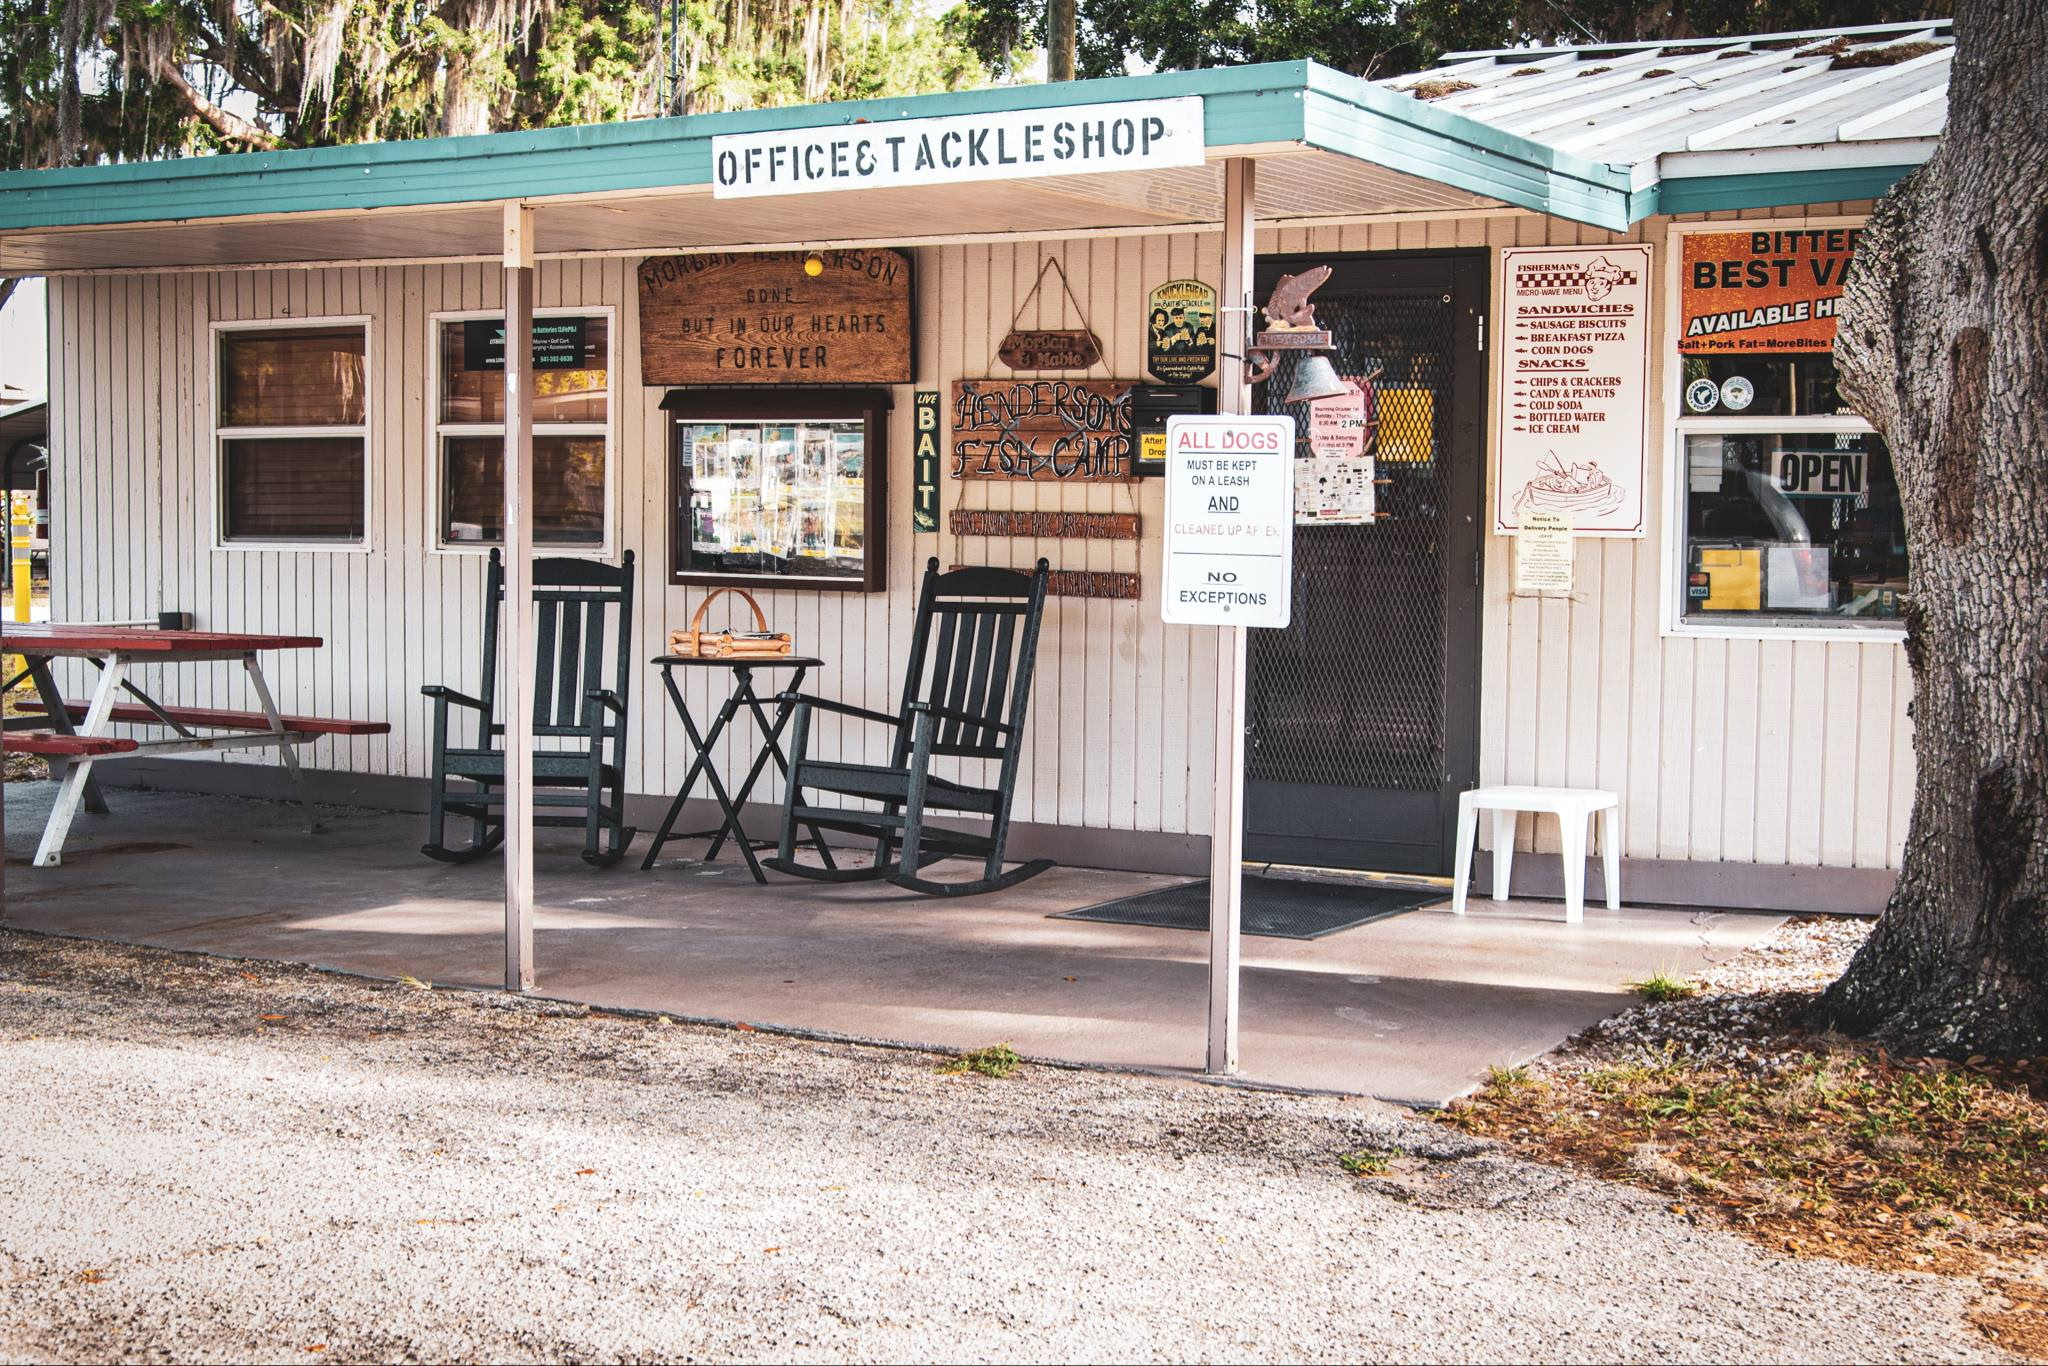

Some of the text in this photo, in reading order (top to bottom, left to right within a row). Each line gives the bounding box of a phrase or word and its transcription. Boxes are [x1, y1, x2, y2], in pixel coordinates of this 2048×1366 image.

[1518, 263, 1580, 272] FISHERMAN'S
[1693, 259, 1795, 289] BEST
[746, 288, 793, 304] GONE
[1157, 283, 1208, 299] KNUCKLEHEAD
[1517, 288, 1583, 297] MICRO-WAVE MENU
[1518, 304, 1634, 315] SANDWICHES
[682, 314, 886, 333] BUT IN OUR HEARTS
[1530, 320, 1627, 329] SAUSAGE BISCUITS
[1687, 302, 1809, 336] AVAILABLE
[1010, 334, 1069, 349] Morgan
[1531, 332, 1625, 342] BREAKFAST PIZZA
[1531, 346, 1594, 354] CORN DOGS
[716, 346, 827, 369] FOREVER
[1518, 359, 1586, 368] SNACKS
[1530, 377, 1621, 386] CHIPS & CRACKERS
[917, 394, 937, 404] LIVE
[1530, 389, 1615, 398] CANDY & PEANUTS
[1529, 401, 1583, 410] COLD SODA
[1529, 412, 1606, 422] BOTTLED WATER
[1341, 420, 1347, 428] 2
[1349, 419, 1363, 428] PM
[1529, 425, 1580, 433] ICE CREAM
[1179, 431, 1279, 449] ALL DOGS
[917, 407, 937, 510] BAIT
[951, 433, 1131, 481] FISH CAMP
[1187, 460, 1257, 471] MUST BE KEPT
[1780, 454, 1862, 492] OPEN
[1192, 475, 1250, 486] ON A LEASH
[1208, 496, 1239, 511] AND
[1174, 524, 1225, 536] CLEANED
[1228, 525, 1241, 536] UP
[1207, 572, 1237, 583] NO
[1180, 591, 1267, 605] EXCEPTIONS
